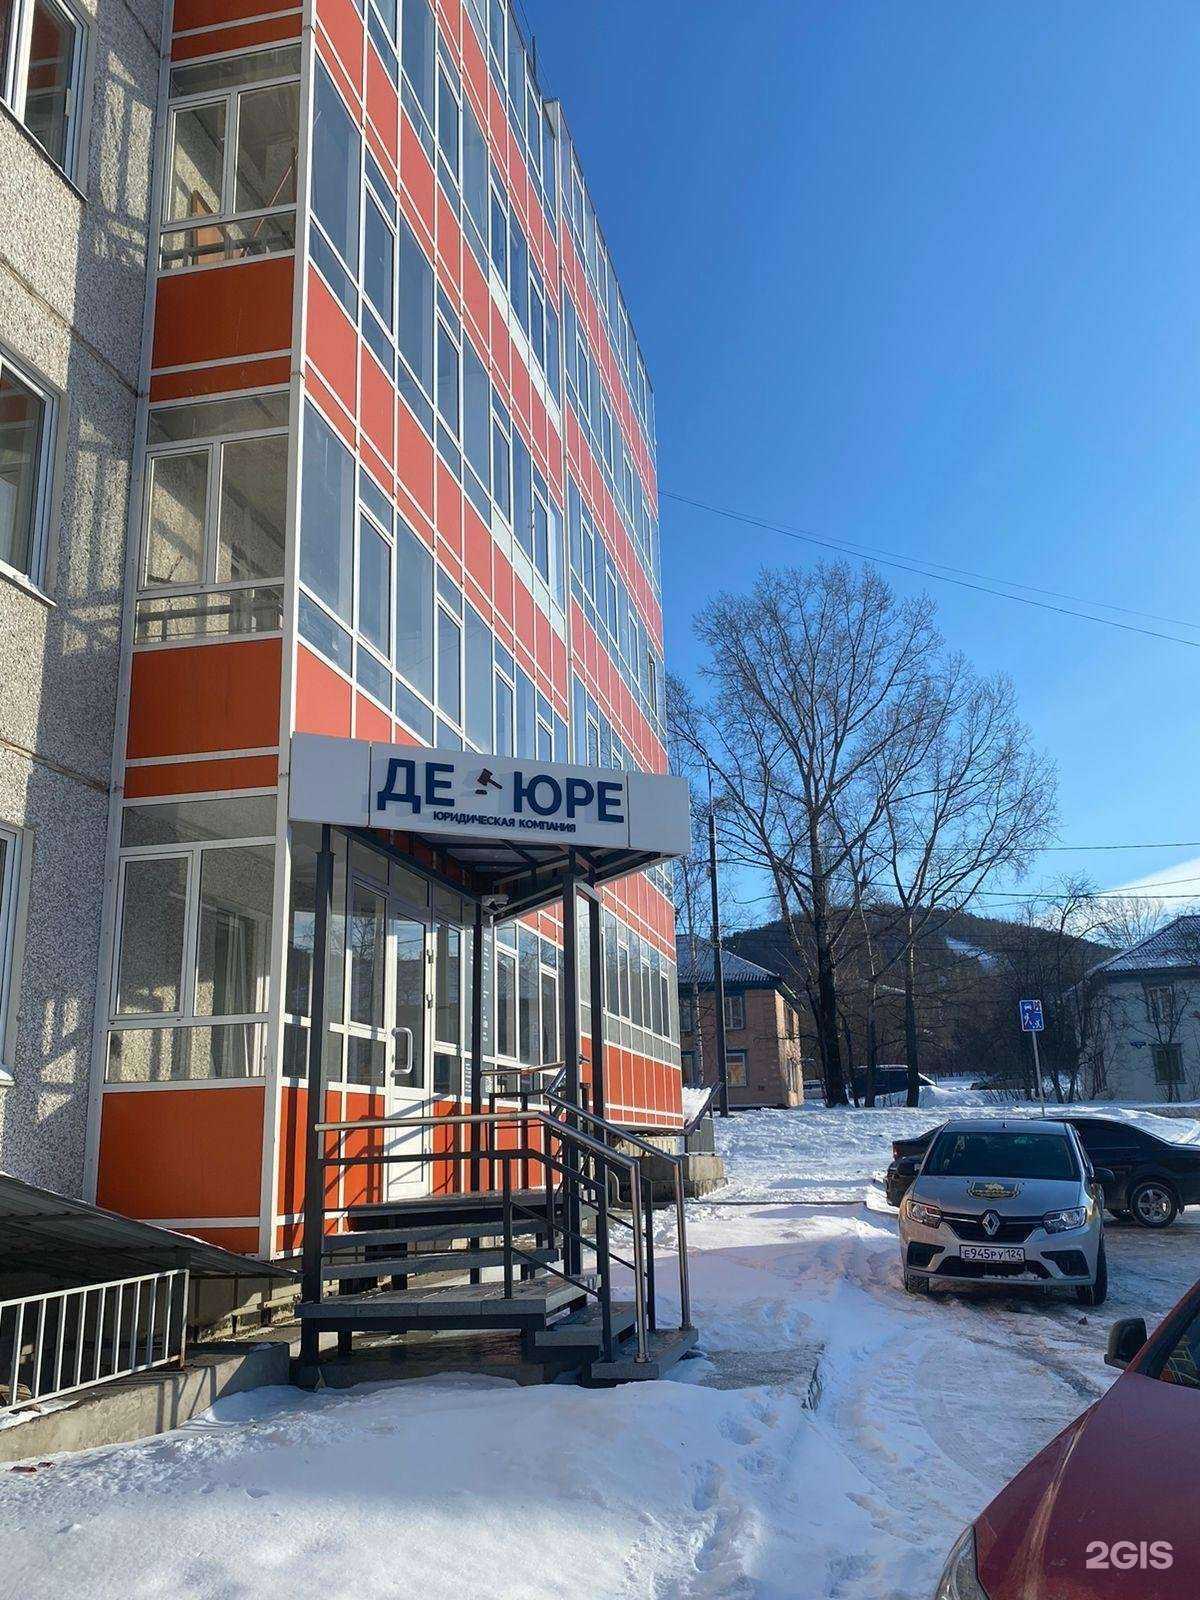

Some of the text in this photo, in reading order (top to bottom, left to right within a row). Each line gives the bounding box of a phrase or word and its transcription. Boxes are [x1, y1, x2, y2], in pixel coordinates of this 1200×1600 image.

[377, 758, 625, 823] ДЕ ЮРЕ
[433, 811, 576, 833] ЮРИДИЧЕСКАЯ КОМПАНИЯ
